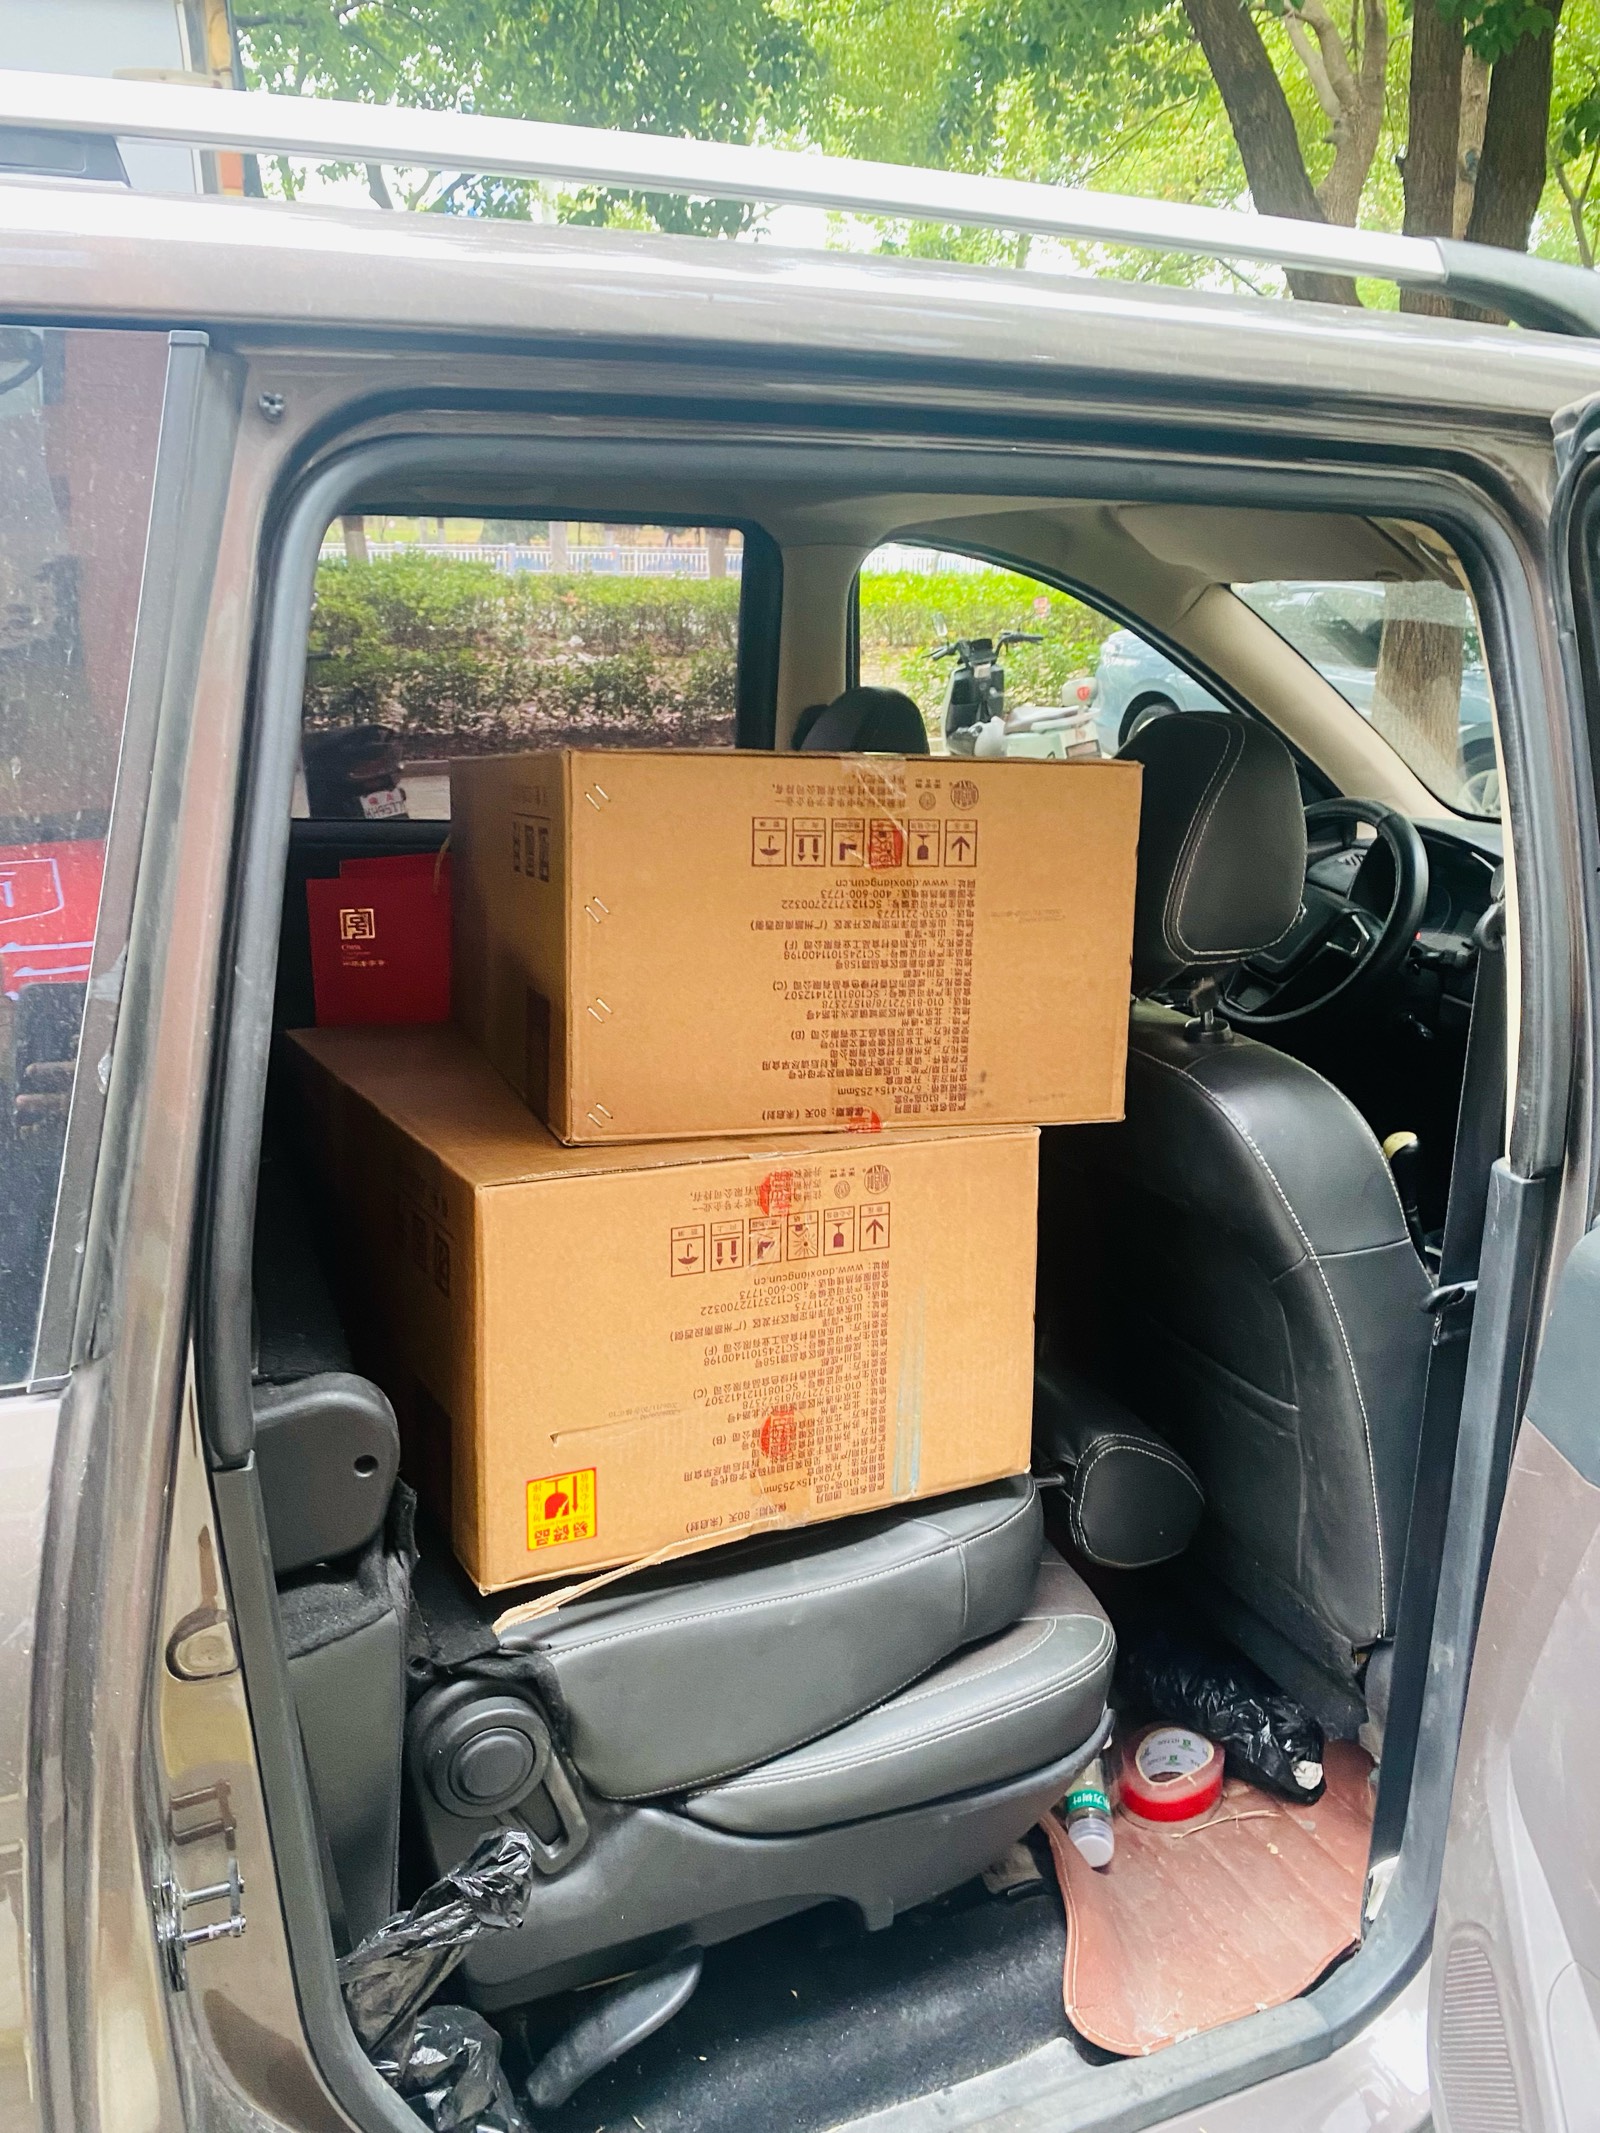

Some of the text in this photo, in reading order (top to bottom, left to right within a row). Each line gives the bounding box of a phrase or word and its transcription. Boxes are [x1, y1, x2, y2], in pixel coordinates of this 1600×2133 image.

[830, 1046, 968, 1057] 委托方：苏州稻香村食品有限公司
[754, 1260, 889, 1286] 网址：www.daoxiangcun.cn
[795, 1290, 889, 1311] 电话：0530-2211773
[535, 1521, 587, 1546] 易碎品
